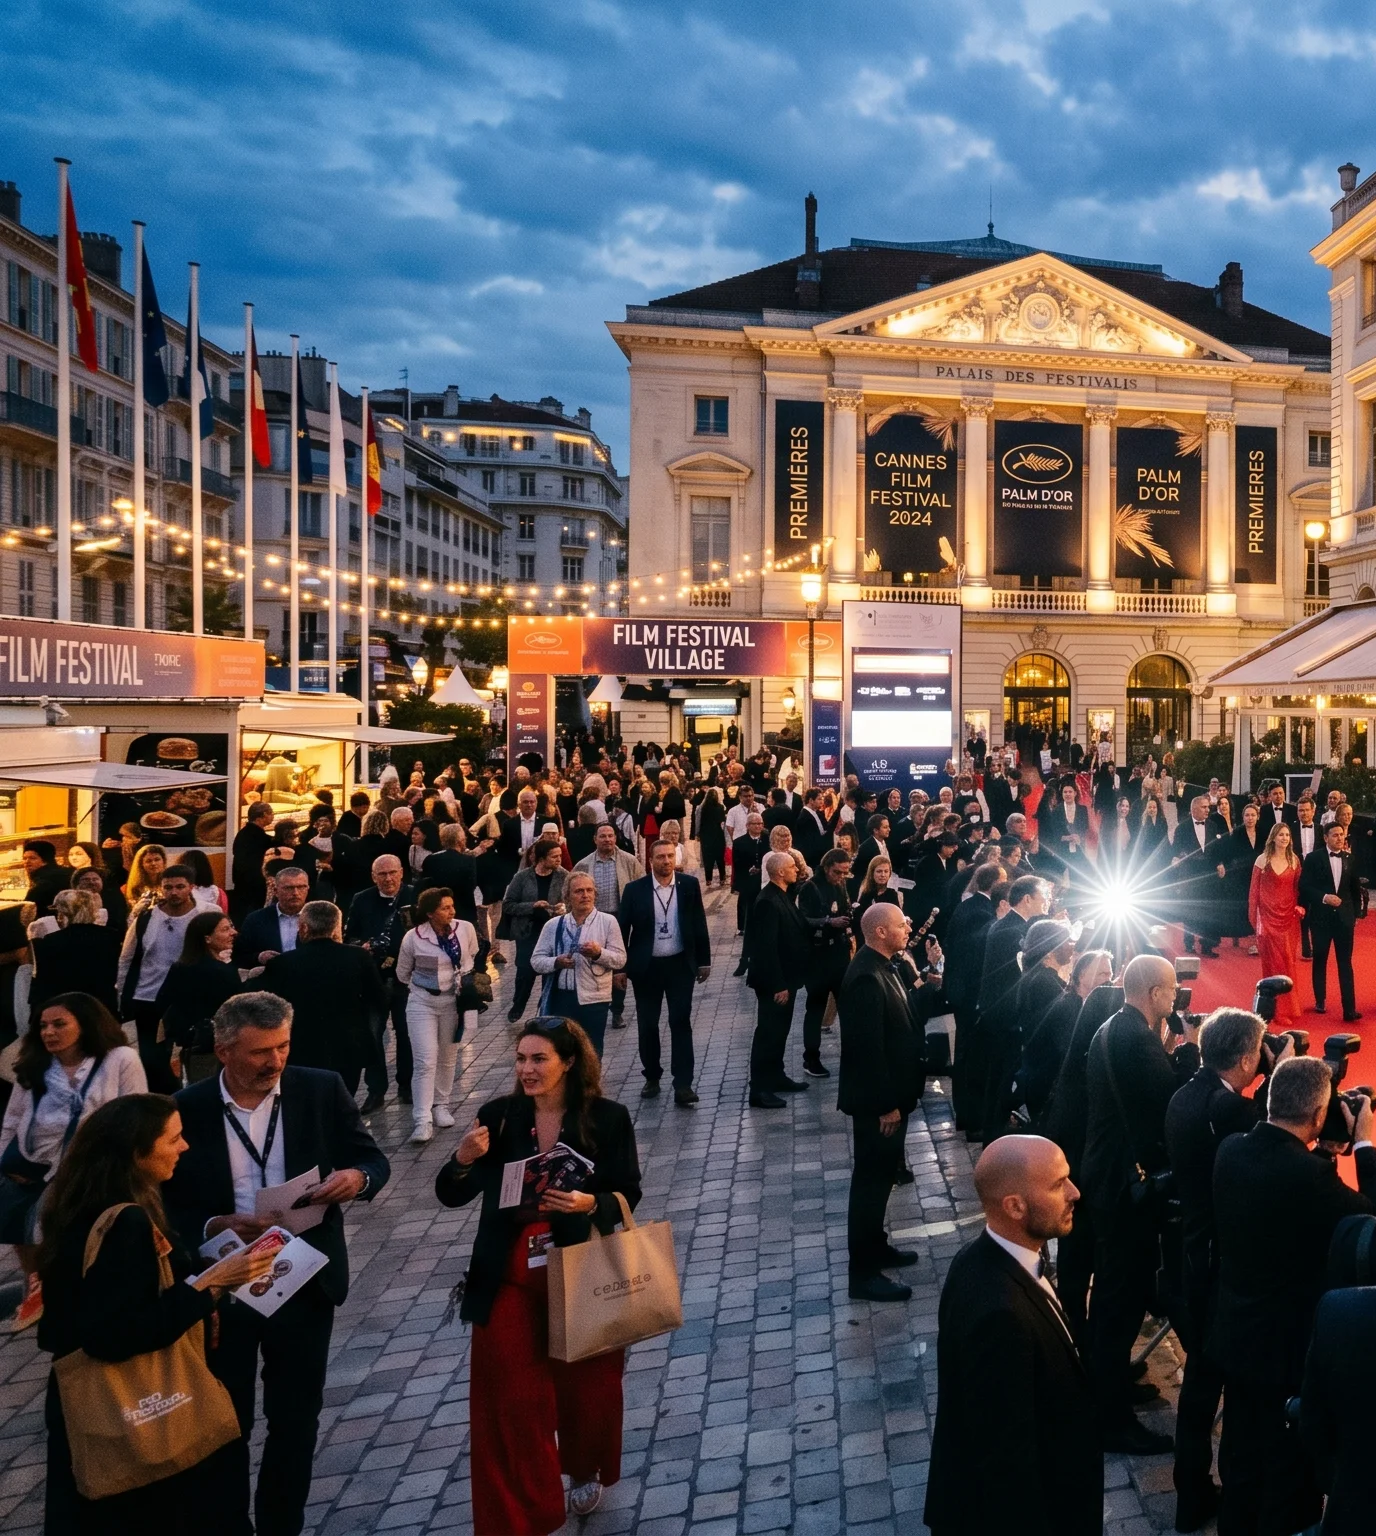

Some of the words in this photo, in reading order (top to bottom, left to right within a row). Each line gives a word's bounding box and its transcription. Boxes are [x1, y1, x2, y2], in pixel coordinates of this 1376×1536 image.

[936, 366, 993, 380] PALAIS
[1005, 370, 1034, 382] DES
[1046, 373, 1137, 389] FESTIVALIS
[875, 452, 947, 470] CANNES
[891, 472, 931, 488] FILM
[1137, 468, 1181, 484] PALM
[870, 490, 952, 508] FESTIVAL
[1002, 488, 1038, 501] PALM
[1041, 490, 1073, 502] D'OR
[1139, 486, 1179, 501] D'OR
[1249, 450, 1264, 554] PREMIERES
[889, 510, 933, 526] 2024
[613, 624, 659, 645] FILM
[666, 625, 755, 647] FESTIVAL
[56, 639, 143, 686] FESTIVAL
[644, 648, 725, 670] VILLAGE
